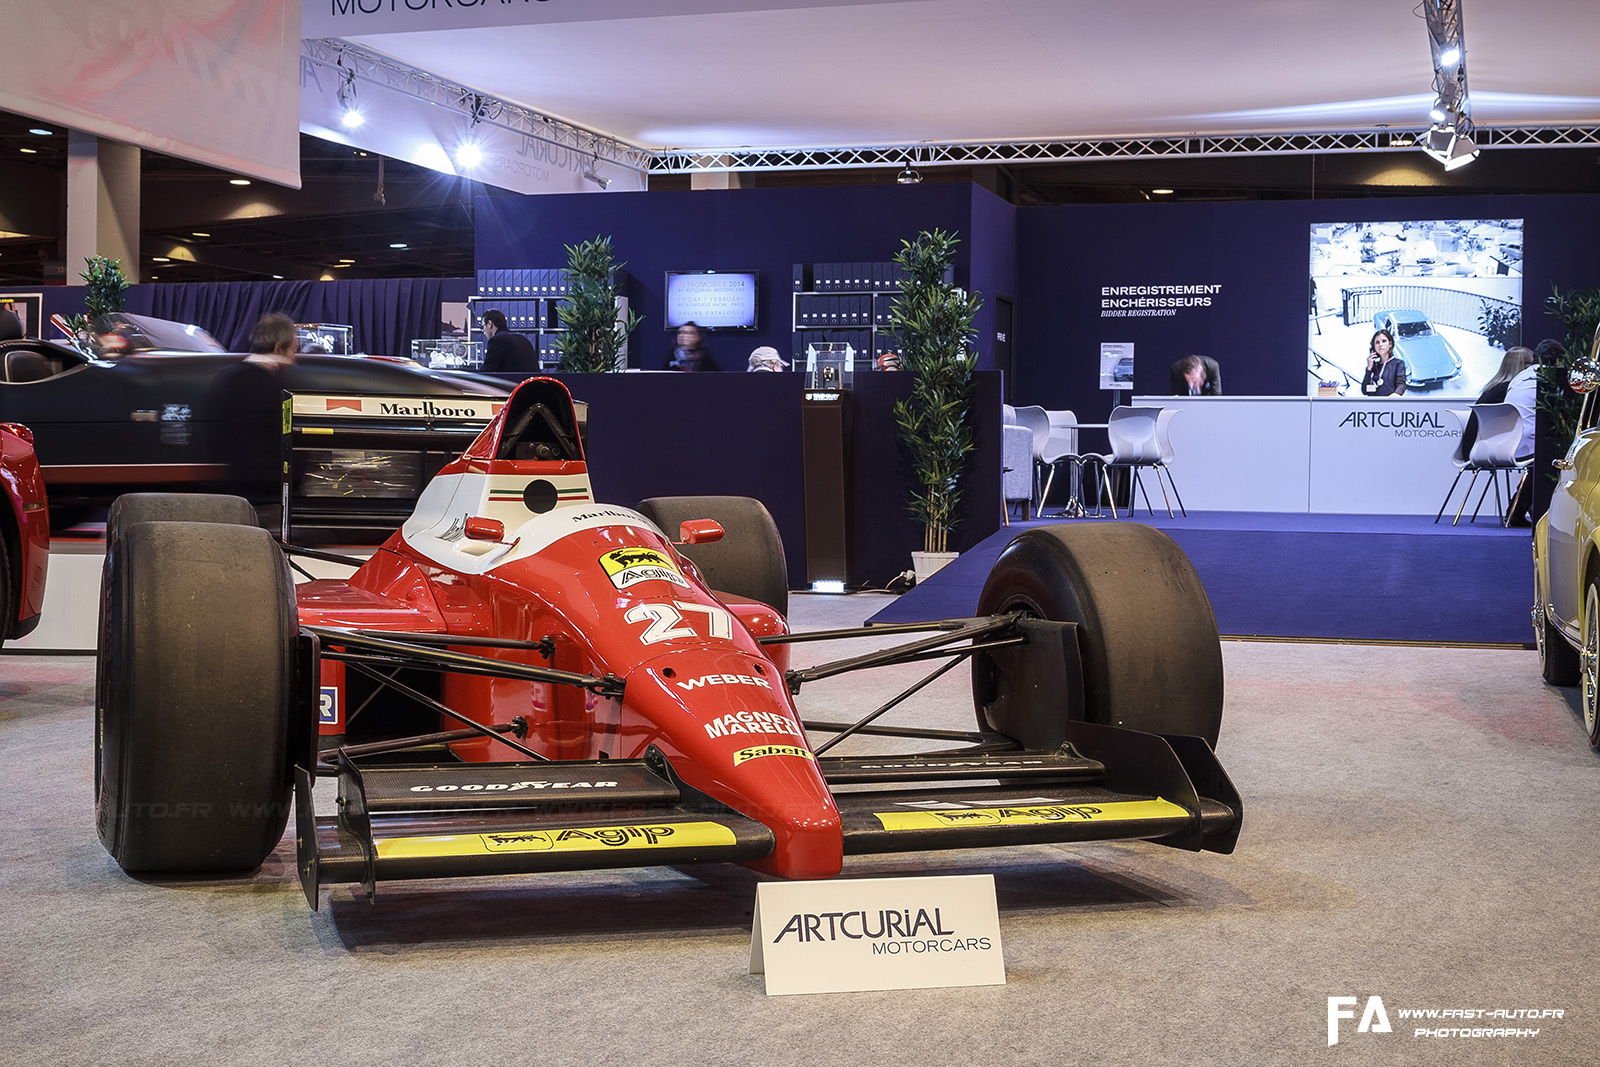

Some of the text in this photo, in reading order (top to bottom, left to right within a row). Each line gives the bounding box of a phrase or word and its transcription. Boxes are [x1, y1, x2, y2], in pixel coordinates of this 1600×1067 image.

[332, 0, 551, 16] MOTOR
[1101, 285, 1222, 296] ENREGISTREMENT
[1101, 297, 1212, 308] ENCHÉRISSEURS
[1127, 309, 1177, 317] REGISTRATION
[380, 401, 476, 417] Marlboro
[621, 568, 684, 585] Agip
[624, 600, 733, 646] 27
[677, 674, 773, 691] WEBER
[410, 781, 618, 792] GOODYEAR
[999, 805, 1102, 821] Agip
[556, 826, 675, 846] Agip
[872, 937, 992, 955] MOTORCARS
